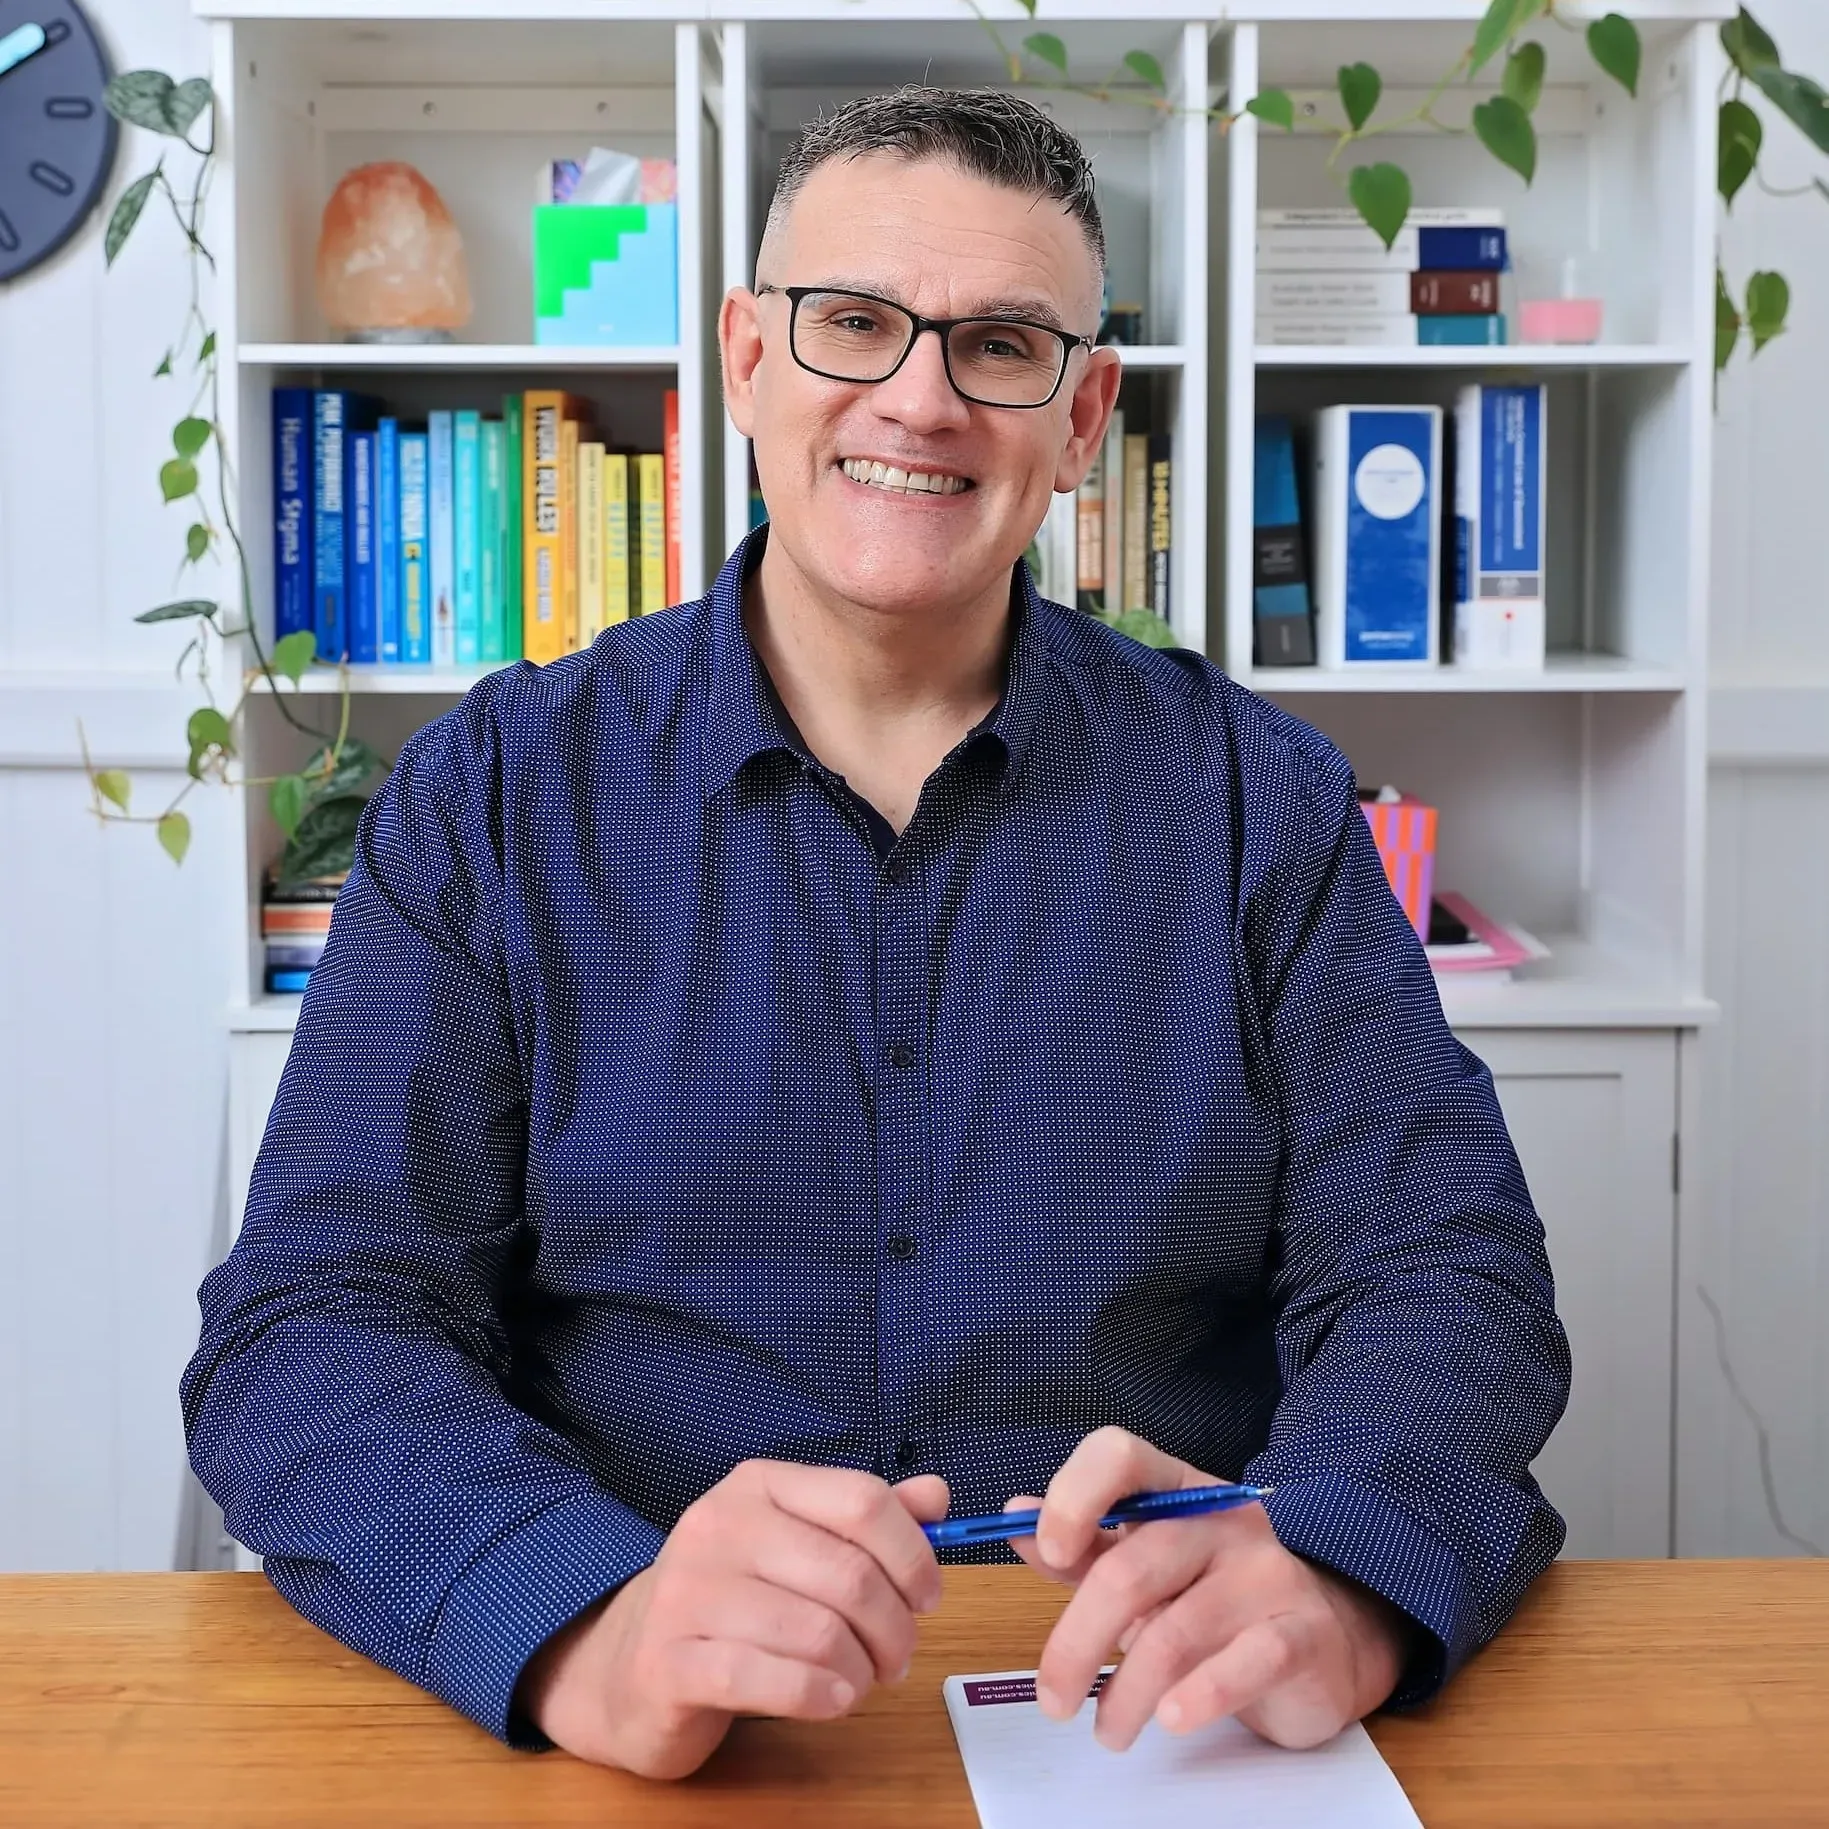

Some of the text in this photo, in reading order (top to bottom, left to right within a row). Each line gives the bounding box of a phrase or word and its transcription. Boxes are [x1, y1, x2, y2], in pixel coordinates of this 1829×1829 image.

[323, 393, 343, 426] PEAK
[534, 406, 559, 462] WORK
[281, 416, 302, 492] Human
[323, 427, 343, 513] PERFORMANCE
[1153, 480, 1170, 551] MINUTES
